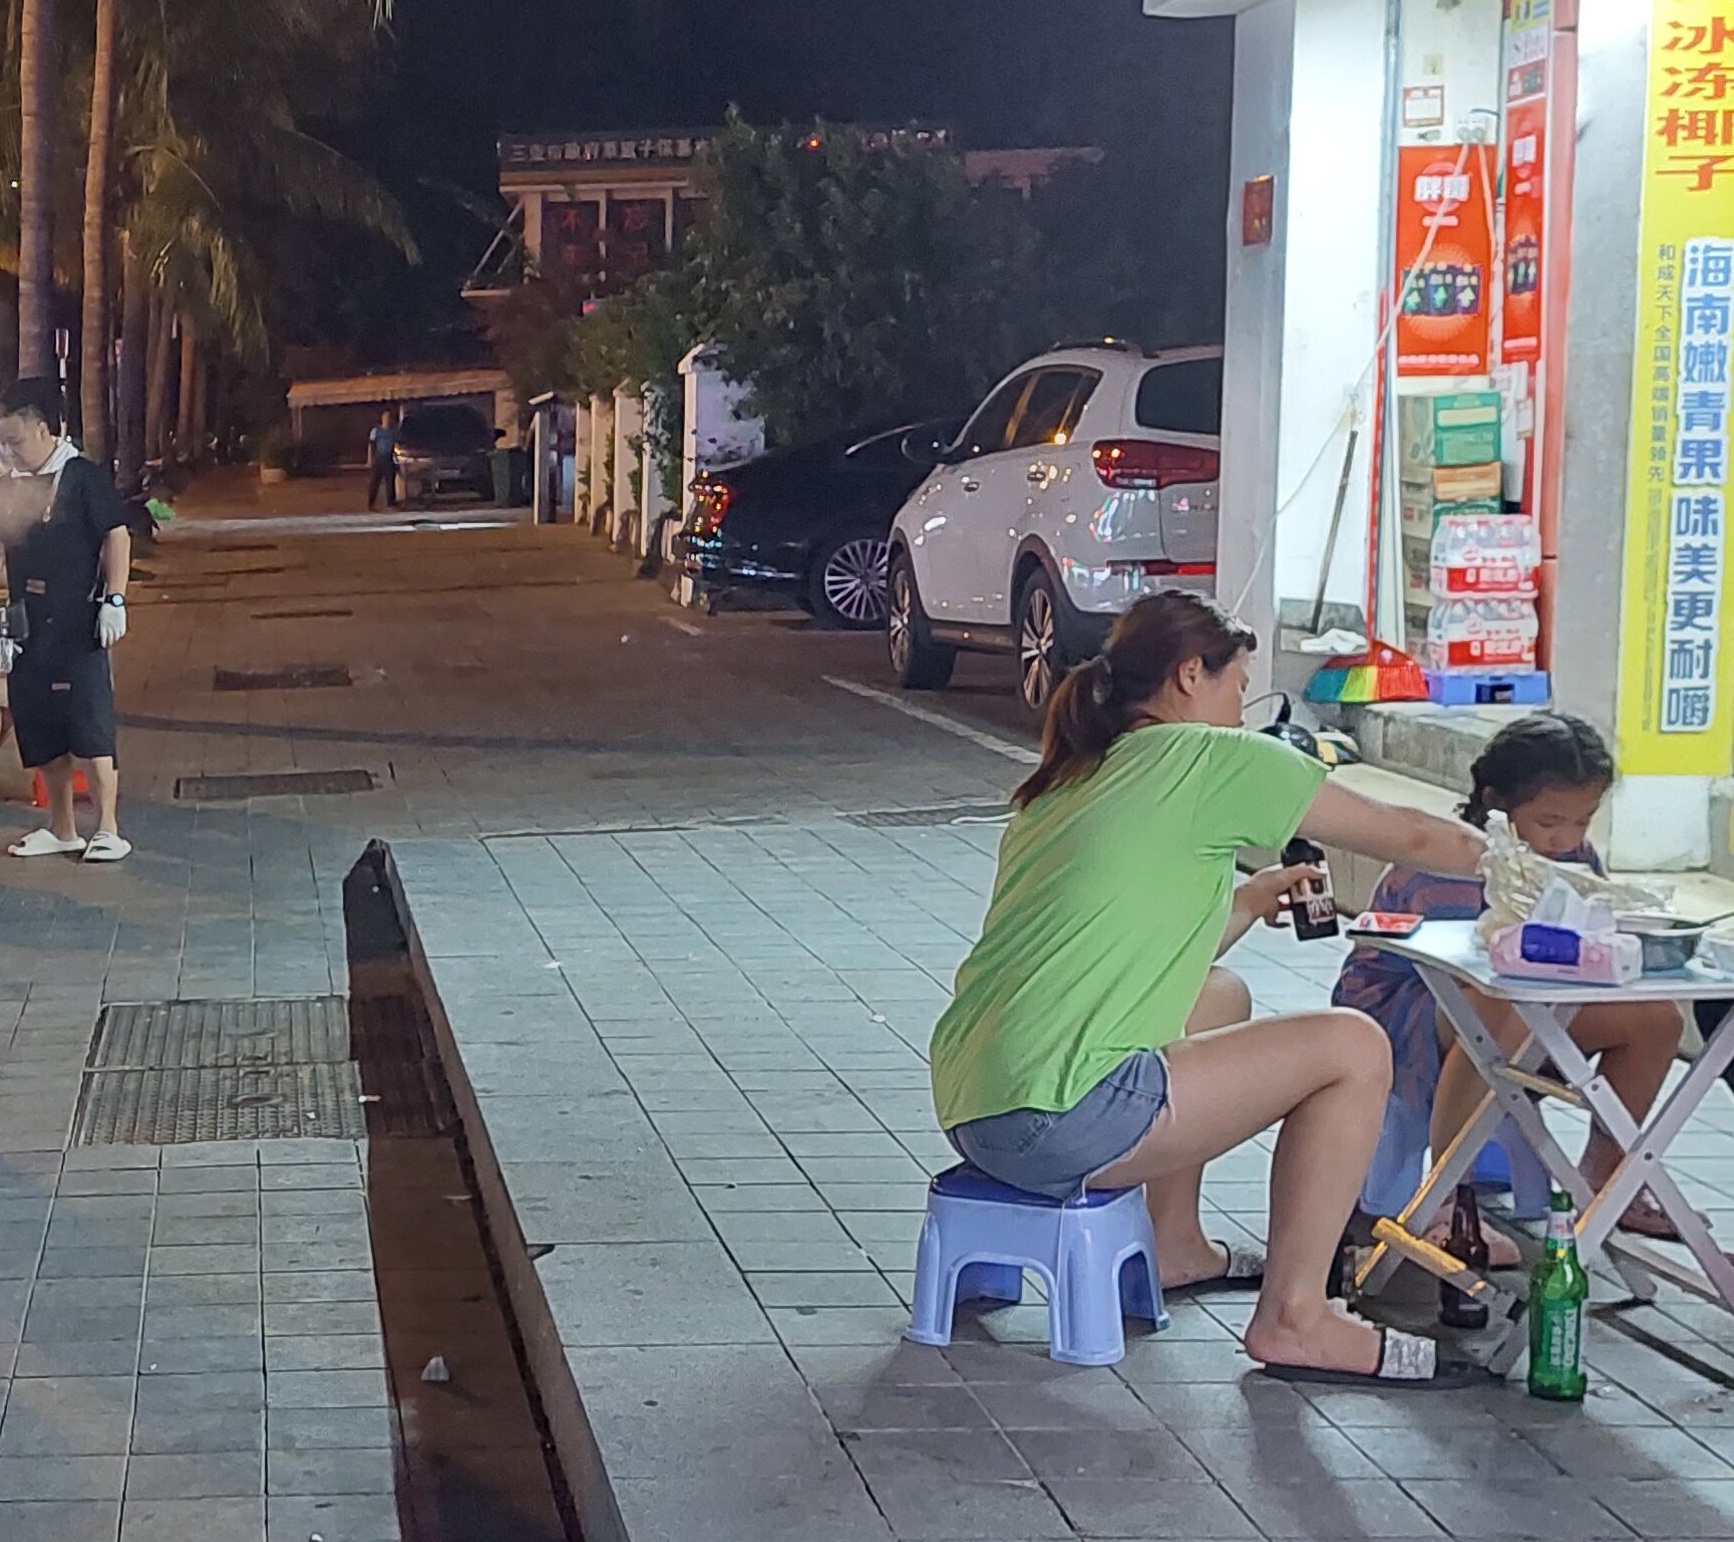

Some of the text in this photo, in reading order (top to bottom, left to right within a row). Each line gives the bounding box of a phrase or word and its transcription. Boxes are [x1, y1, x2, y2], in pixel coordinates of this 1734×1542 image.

[1666, 244, 1733, 727] 海南嫩青果 味美更耐嚼
